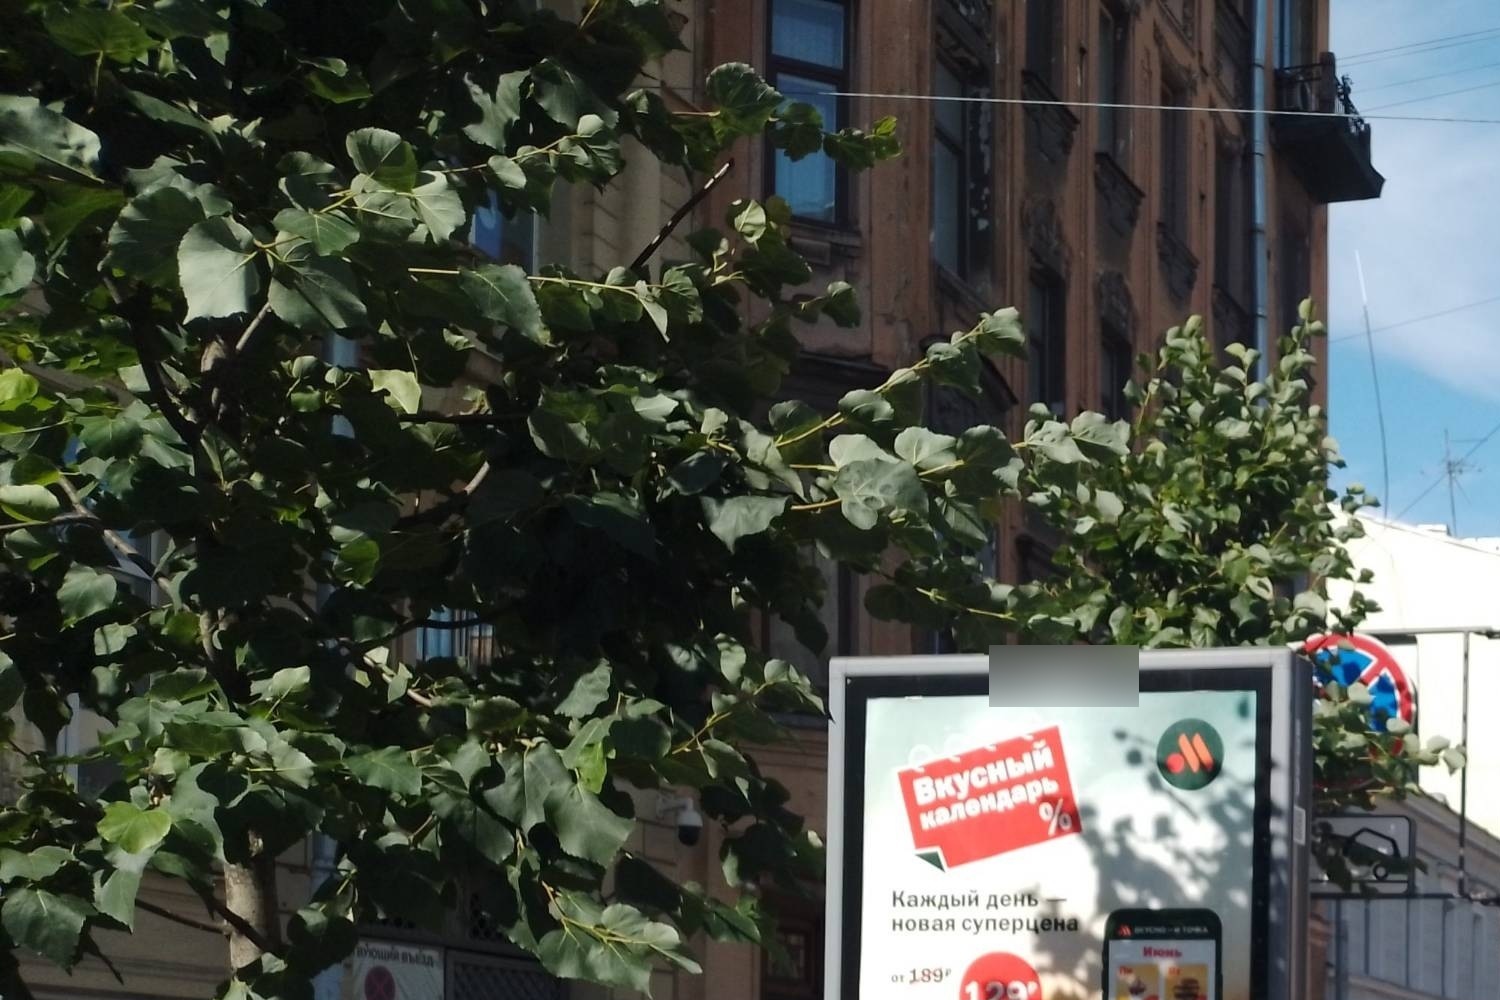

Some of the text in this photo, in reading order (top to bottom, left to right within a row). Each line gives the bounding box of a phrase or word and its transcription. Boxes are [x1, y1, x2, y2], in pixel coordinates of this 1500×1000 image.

[913, 739, 1055, 806] Вкусный
[919, 777, 1059, 831] календарь
[892, 889, 980, 911] Каждый
[986, 893, 1039, 911] день
[892, 917, 1079, 936] новая суперцена
[1143, 946, 1183, 959] Июнь
[891, 974, 904, 983] от
